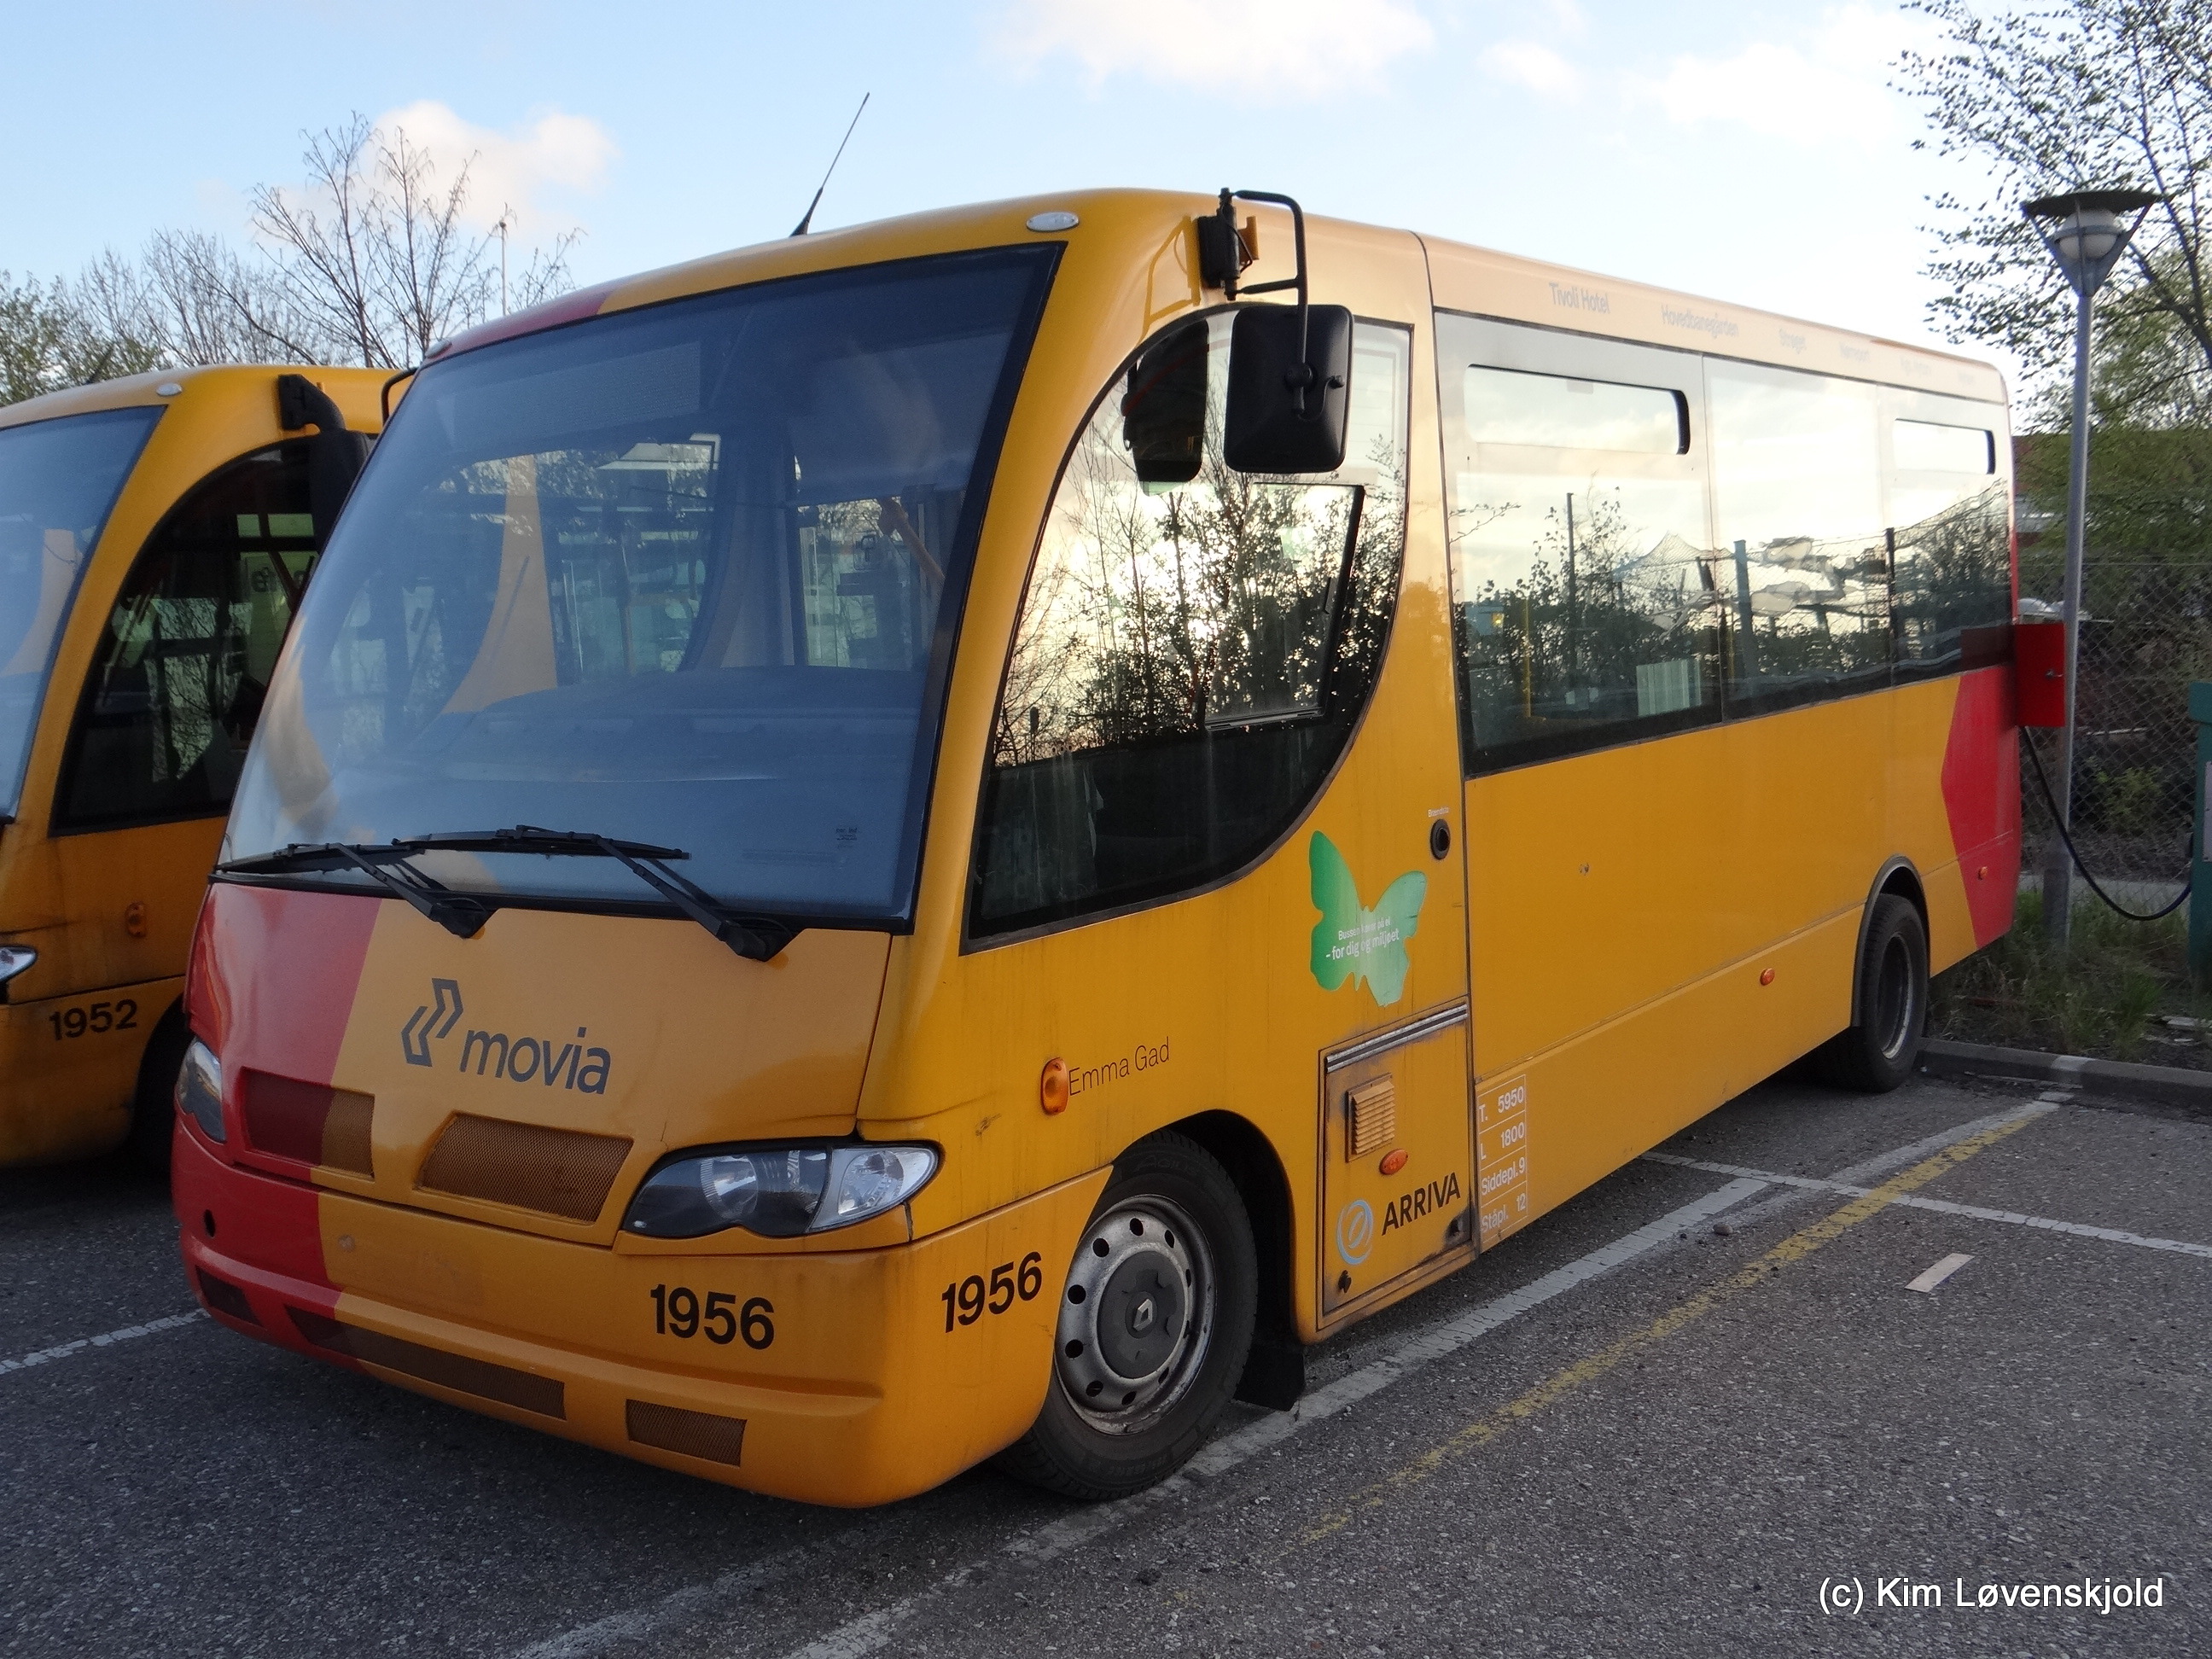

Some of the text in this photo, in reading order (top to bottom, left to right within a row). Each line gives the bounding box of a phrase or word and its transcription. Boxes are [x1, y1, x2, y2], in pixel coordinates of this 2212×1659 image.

[1549, 281, 1611, 315] Tivoli Hotel
[1332, 946, 1344, 960] for
[1347, 940, 1359, 958] dig
[1360, 940, 1371, 954] og
[1371, 928, 1400, 948] miljøet
[1338, 928, 1360, 940] Bussen
[49, 998, 137, 1040] 1952
[459, 1027, 611, 1095] movia
[1068, 1036, 1169, 1096] Emma Gad
[1479, 1086, 1524, 1123] T. 5950
[1481, 1121, 1525, 1161] L 1800
[1382, 1172, 1461, 1236] ARRIVA
[1481, 1192, 1526, 1233] Ståpl. 12
[940, 1251, 1042, 1333] 1956
[650, 1283, 775, 1350] 1956
